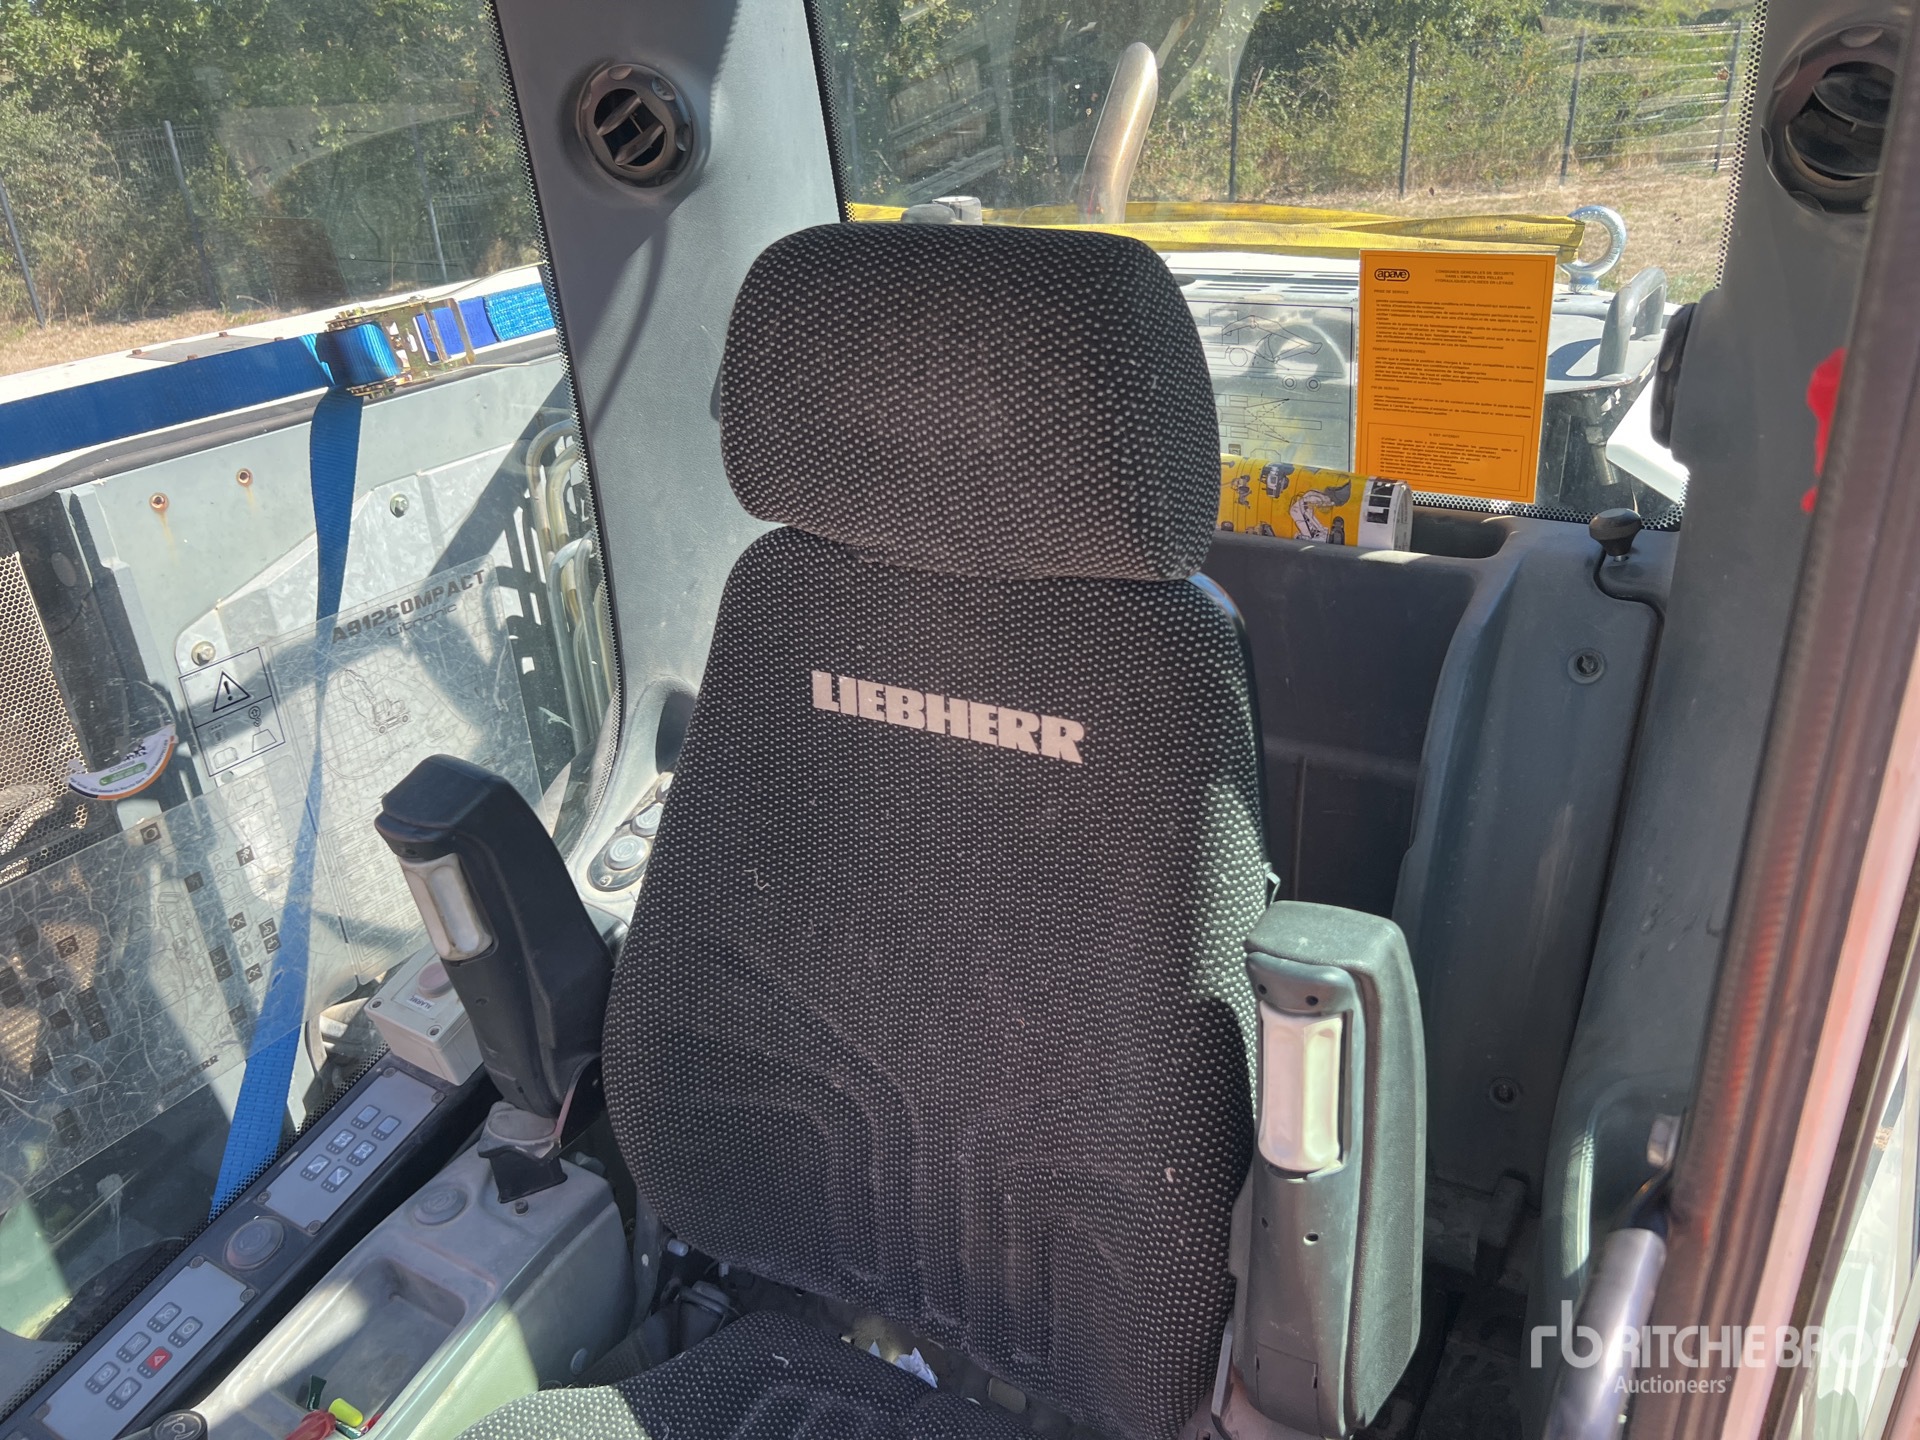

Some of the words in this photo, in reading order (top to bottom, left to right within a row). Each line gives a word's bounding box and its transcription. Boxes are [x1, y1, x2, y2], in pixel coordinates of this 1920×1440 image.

[1376, 269, 1408, 281] apave
[387, 603, 458, 637] Litronic
[811, 670, 1085, 765] LIEBHERR
